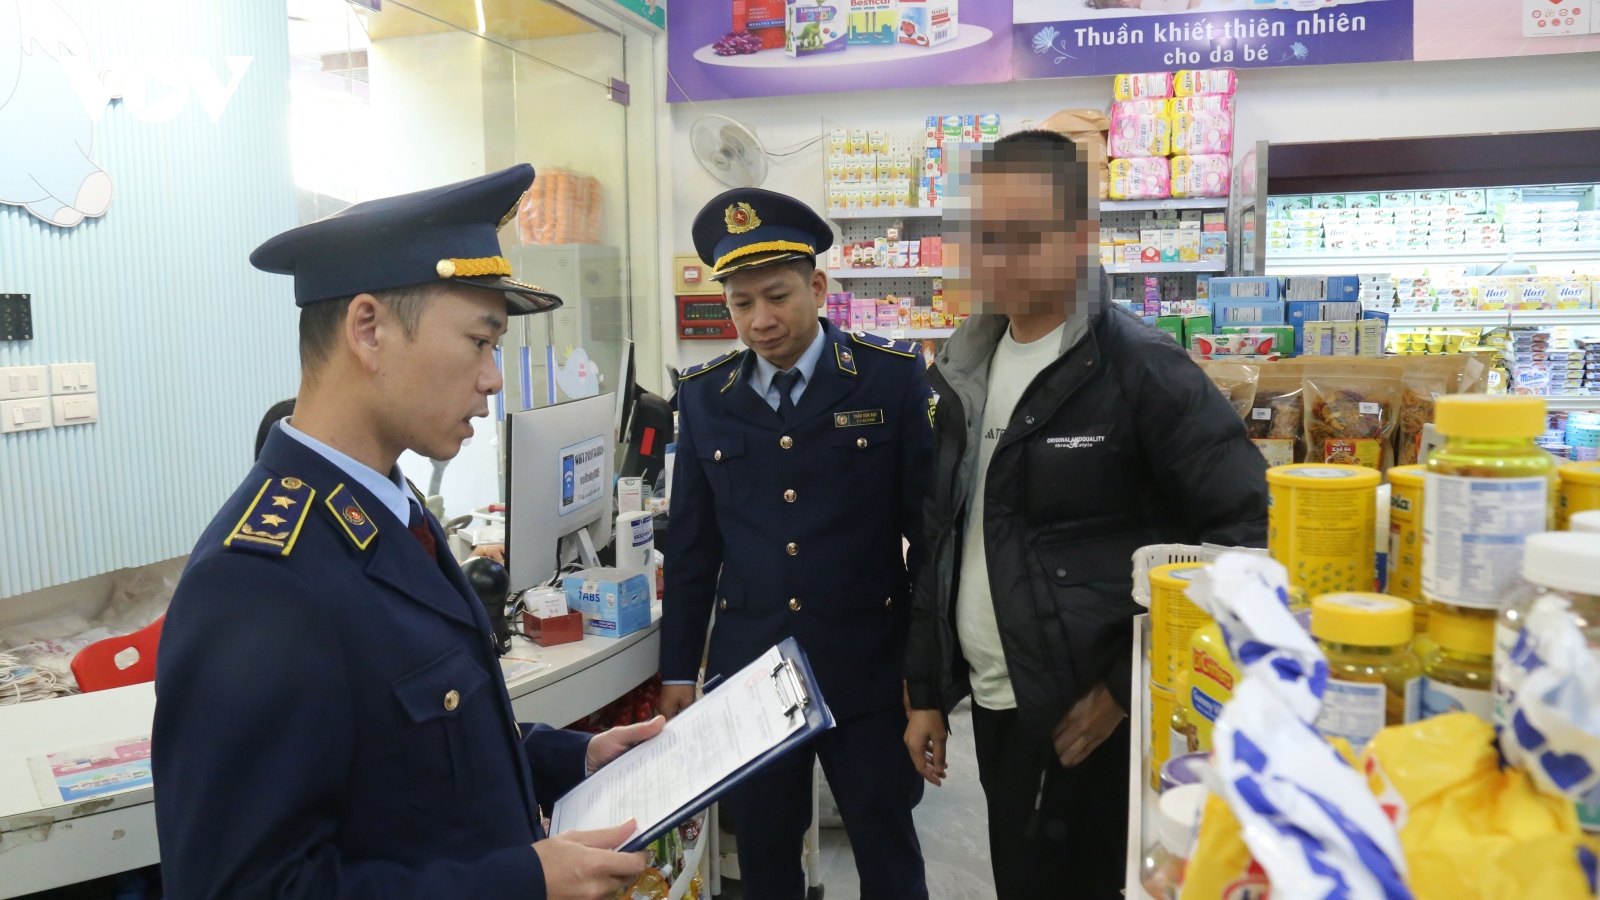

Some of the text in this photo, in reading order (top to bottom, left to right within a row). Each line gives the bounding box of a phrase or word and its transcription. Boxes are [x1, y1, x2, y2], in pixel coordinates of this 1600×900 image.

[1074, 13, 1366, 47] Thuần khiết thiên nhiên
[1164, 44, 1269, 65] cho da bé
[1485, 289, 1509, 297] Hoff
[1522, 289, 1547, 297] Hoff
[1559, 288, 1583, 297] Hoff
[578, 591, 600, 602] TABS
